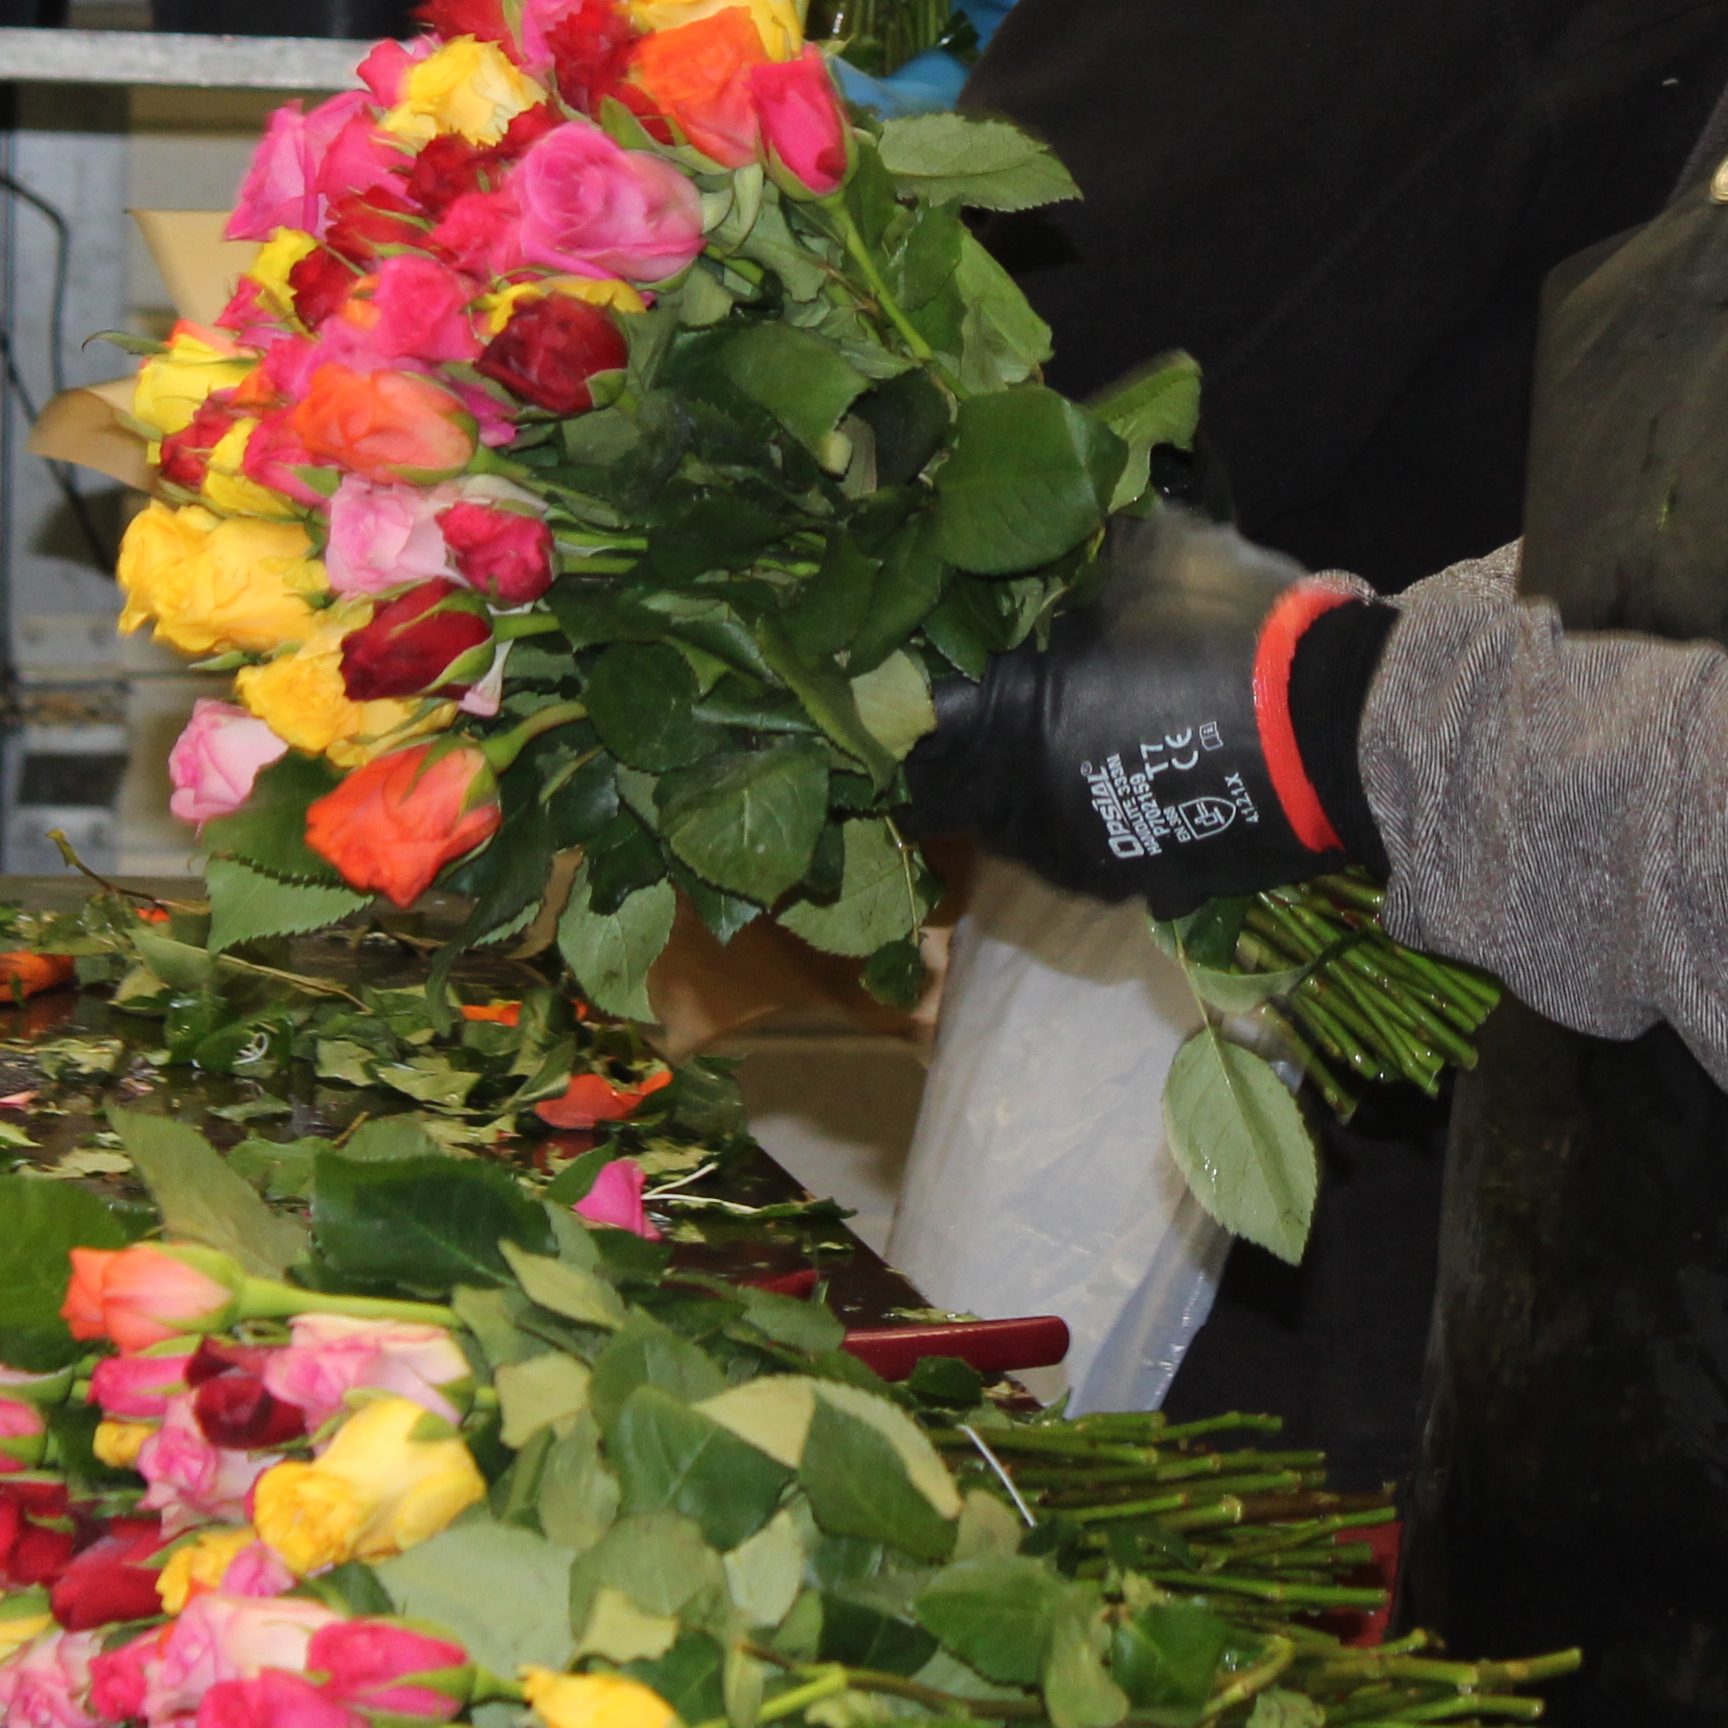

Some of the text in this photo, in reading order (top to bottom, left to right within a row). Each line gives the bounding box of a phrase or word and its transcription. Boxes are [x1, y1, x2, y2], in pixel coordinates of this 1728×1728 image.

[1165, 727, 1199, 770] CE
[1106, 753, 1132, 797] 333N
[1129, 772, 1171, 837] P702159
[1173, 824, 1191, 843] EN
